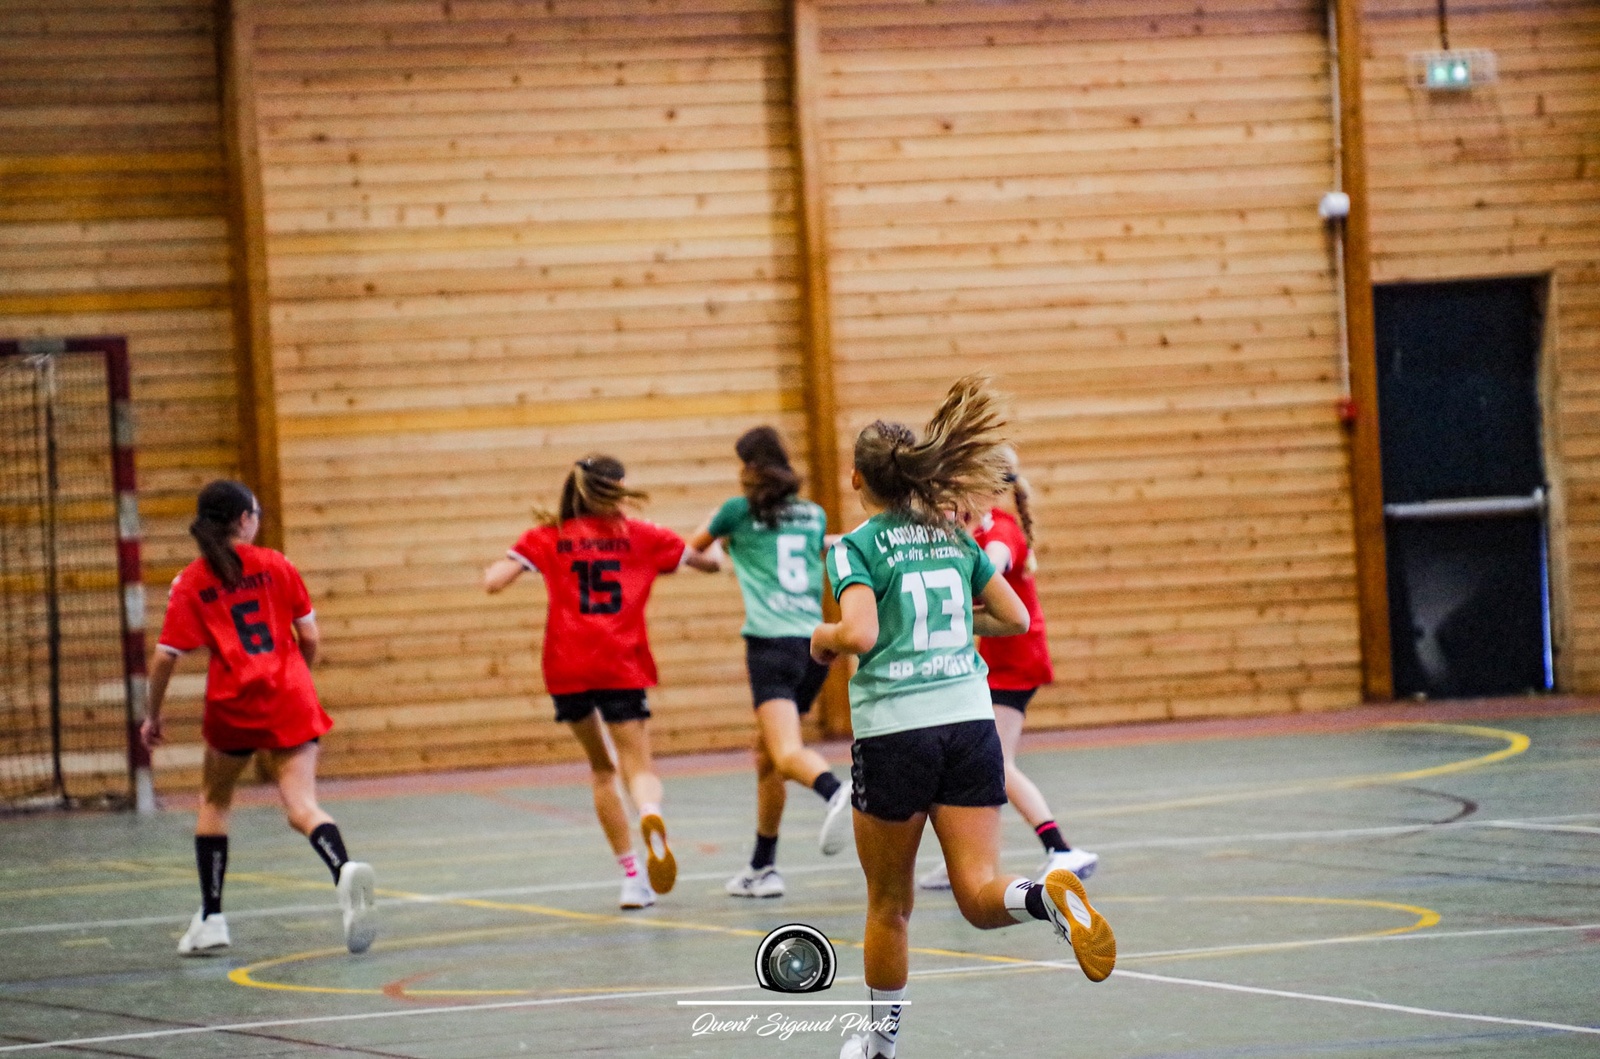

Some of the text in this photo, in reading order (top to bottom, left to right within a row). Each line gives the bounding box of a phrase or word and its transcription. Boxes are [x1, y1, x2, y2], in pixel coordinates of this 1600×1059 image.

[776, 534, 809, 594] 6
[886, 550, 904, 568] BAR
[571, 560, 622, 615] 15
[901, 567, 968, 652] 13
[230, 599, 275, 655] 6
